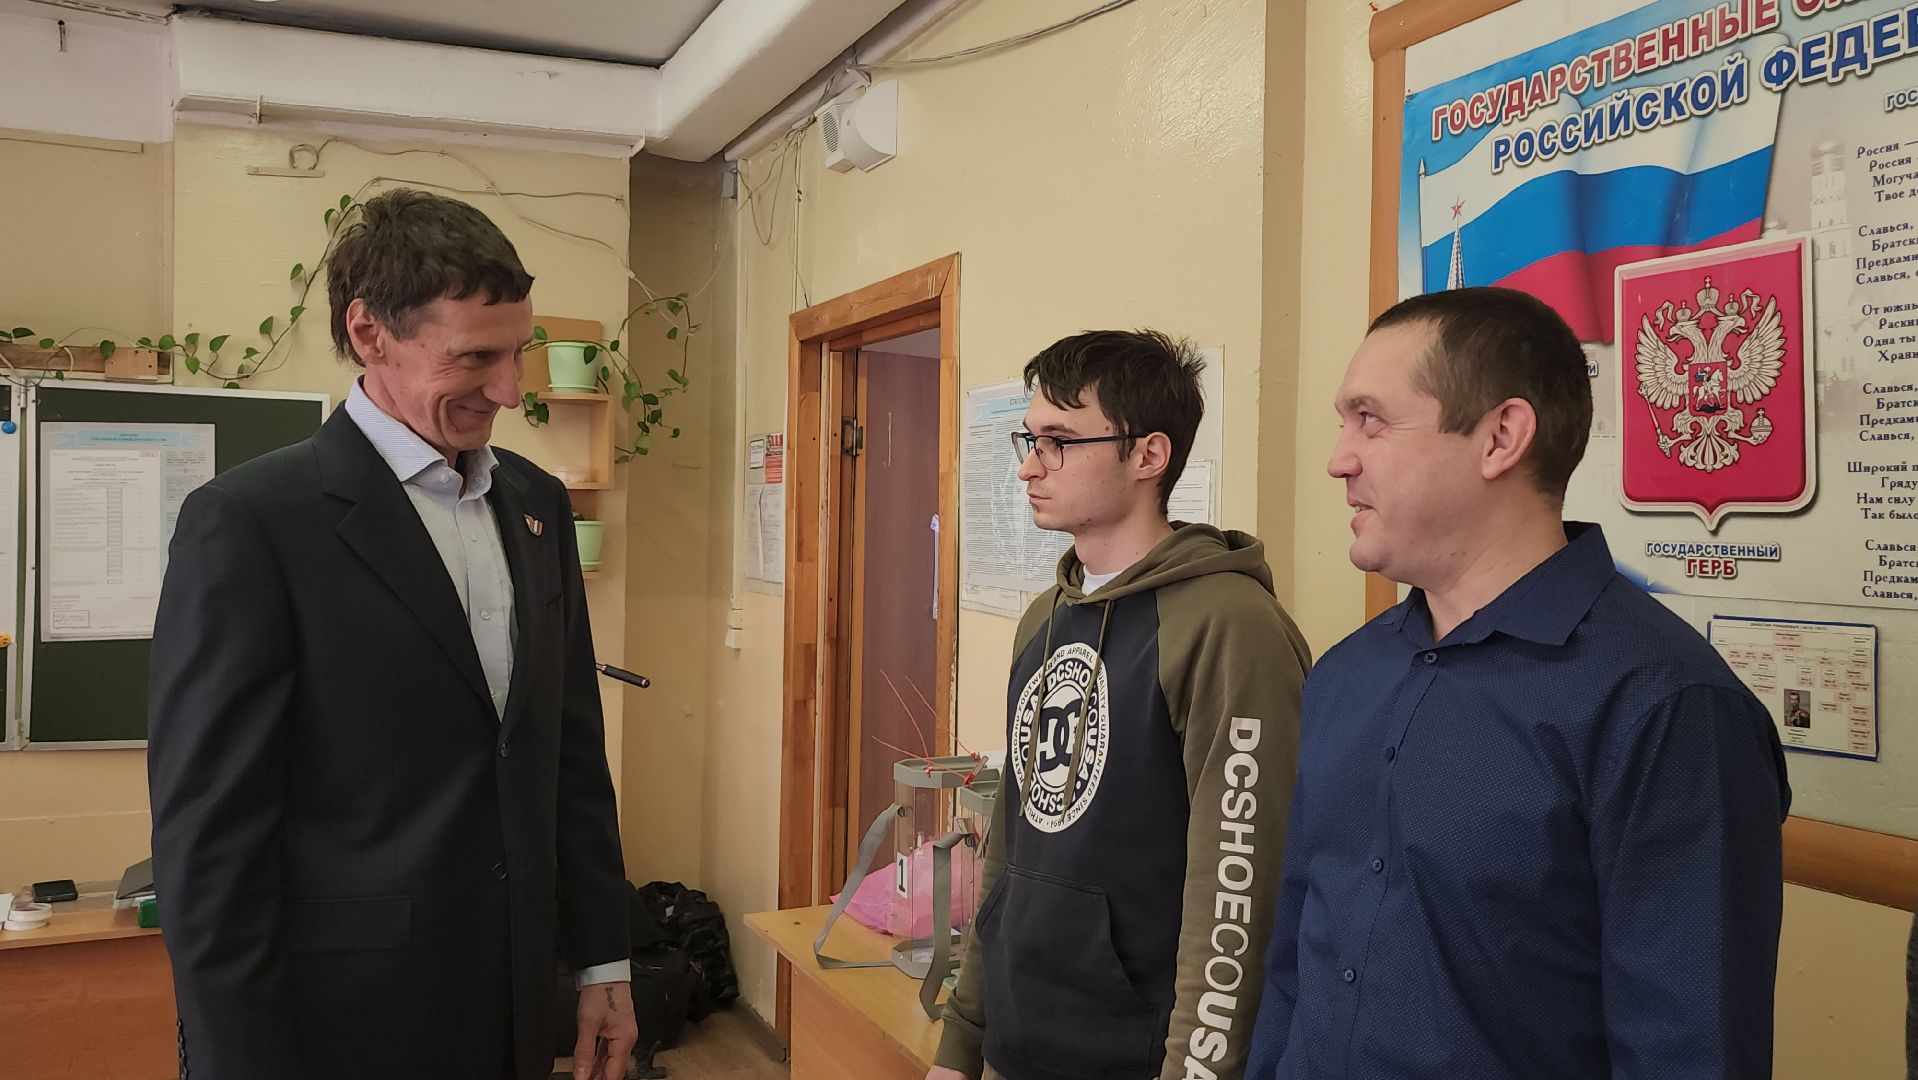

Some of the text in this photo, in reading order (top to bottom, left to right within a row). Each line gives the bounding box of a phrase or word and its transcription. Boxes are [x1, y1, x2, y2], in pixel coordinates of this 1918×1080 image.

[1432, 0, 1778, 138] ГОСУДАРСТВЕННЫЕ
[1492, 55, 1746, 171] РОССИЙСКОЙ
[1857, 143, 1900, 159] Россия
[1869, 157, 1912, 172] Россия
[1872, 171, 1918, 188] Могуча
[1874, 189, 1905, 202] Твое
[1858, 222, 1914, 237] Славься,
[1871, 237, 1918, 252] Братск
[1856, 271, 1910, 285] Славься,
[1861, 304, 1880, 316] От
[1863, 335, 1916, 347] Одна ты
[1862, 383, 1918, 394] Славься,
[1859, 430, 1915, 442] Славься,
[1847, 460, 1908, 475] Широкий
[1880, 476, 1918, 491] Гряду
[1856, 493, 1915, 506] Нам силу
[1860, 507, 1885, 520] Так
[1646, 542, 1778, 558] ГОСУДАРСТВЕННЫЙ
[1686, 558, 1735, 576] ГЕРБ
[1878, 555, 1918, 569] Братс
[1861, 585, 1918, 601] Славься,
[1067, 646, 1093, 664] APPAREL
[1087, 714, 1106, 796] GUARANTEED
[1066, 797, 1088, 822] SINCE
[898, 858, 906, 893] 1
